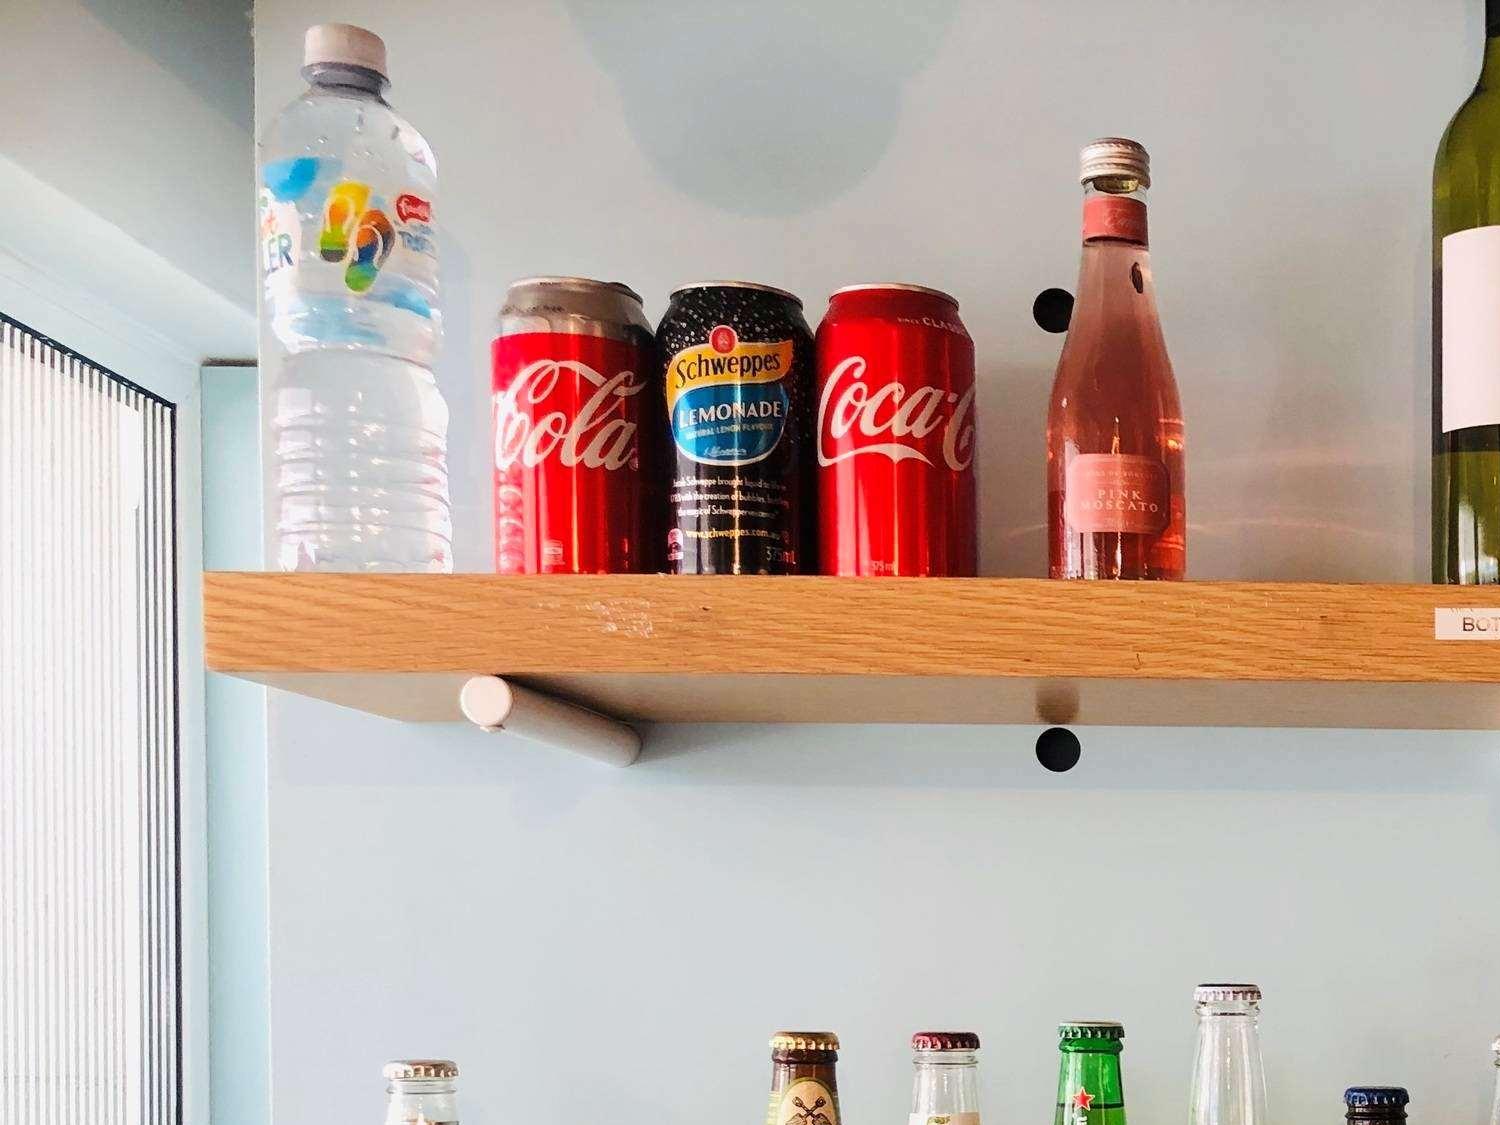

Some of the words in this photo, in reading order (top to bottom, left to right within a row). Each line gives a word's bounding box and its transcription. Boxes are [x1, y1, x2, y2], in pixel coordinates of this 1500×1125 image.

[675, 350, 782, 390] Schweppes
[492, 359, 646, 472] Cola
[679, 400, 783, 428] LEMONADE
[1081, 501, 1158, 513] MOSCATO
[1098, 489, 1142, 501] PINK
